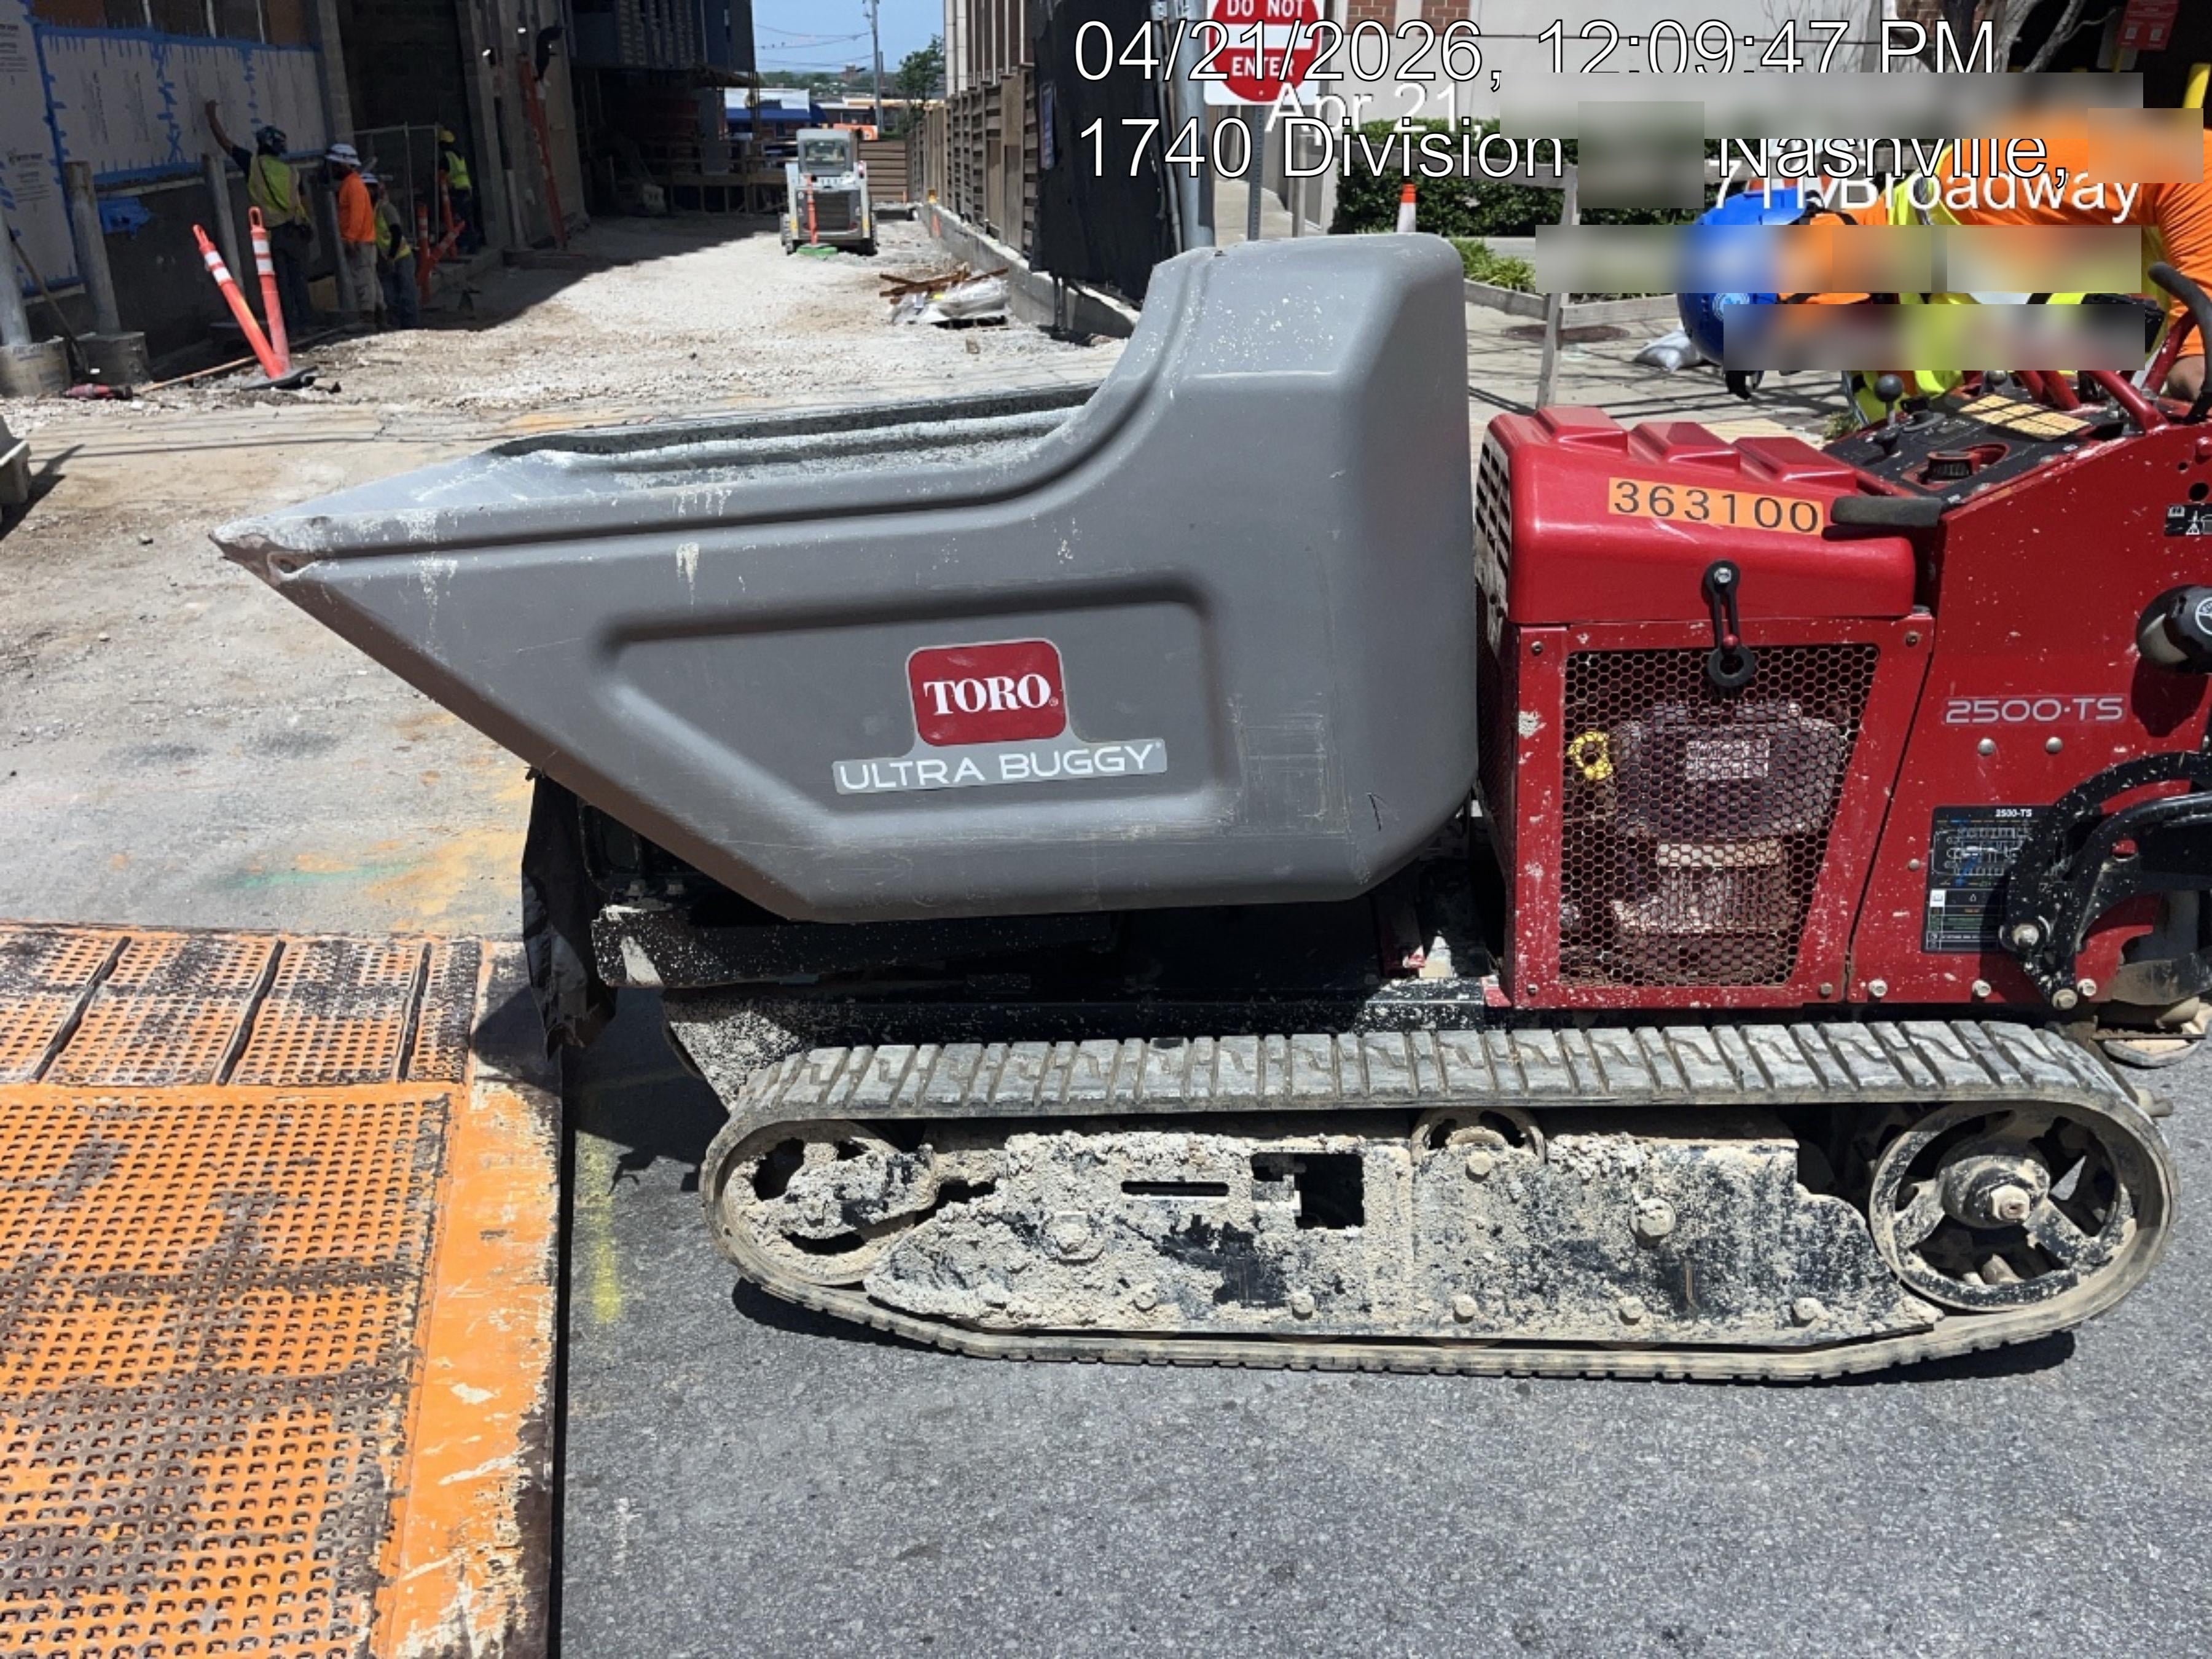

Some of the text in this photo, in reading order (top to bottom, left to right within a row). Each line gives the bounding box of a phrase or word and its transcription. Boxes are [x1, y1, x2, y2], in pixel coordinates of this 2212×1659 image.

[1226, 0, 1304, 17] DO NOT
[1614, 480, 1819, 533] 363100
[839, 743, 1153, 790] ULTRA BUGGY
